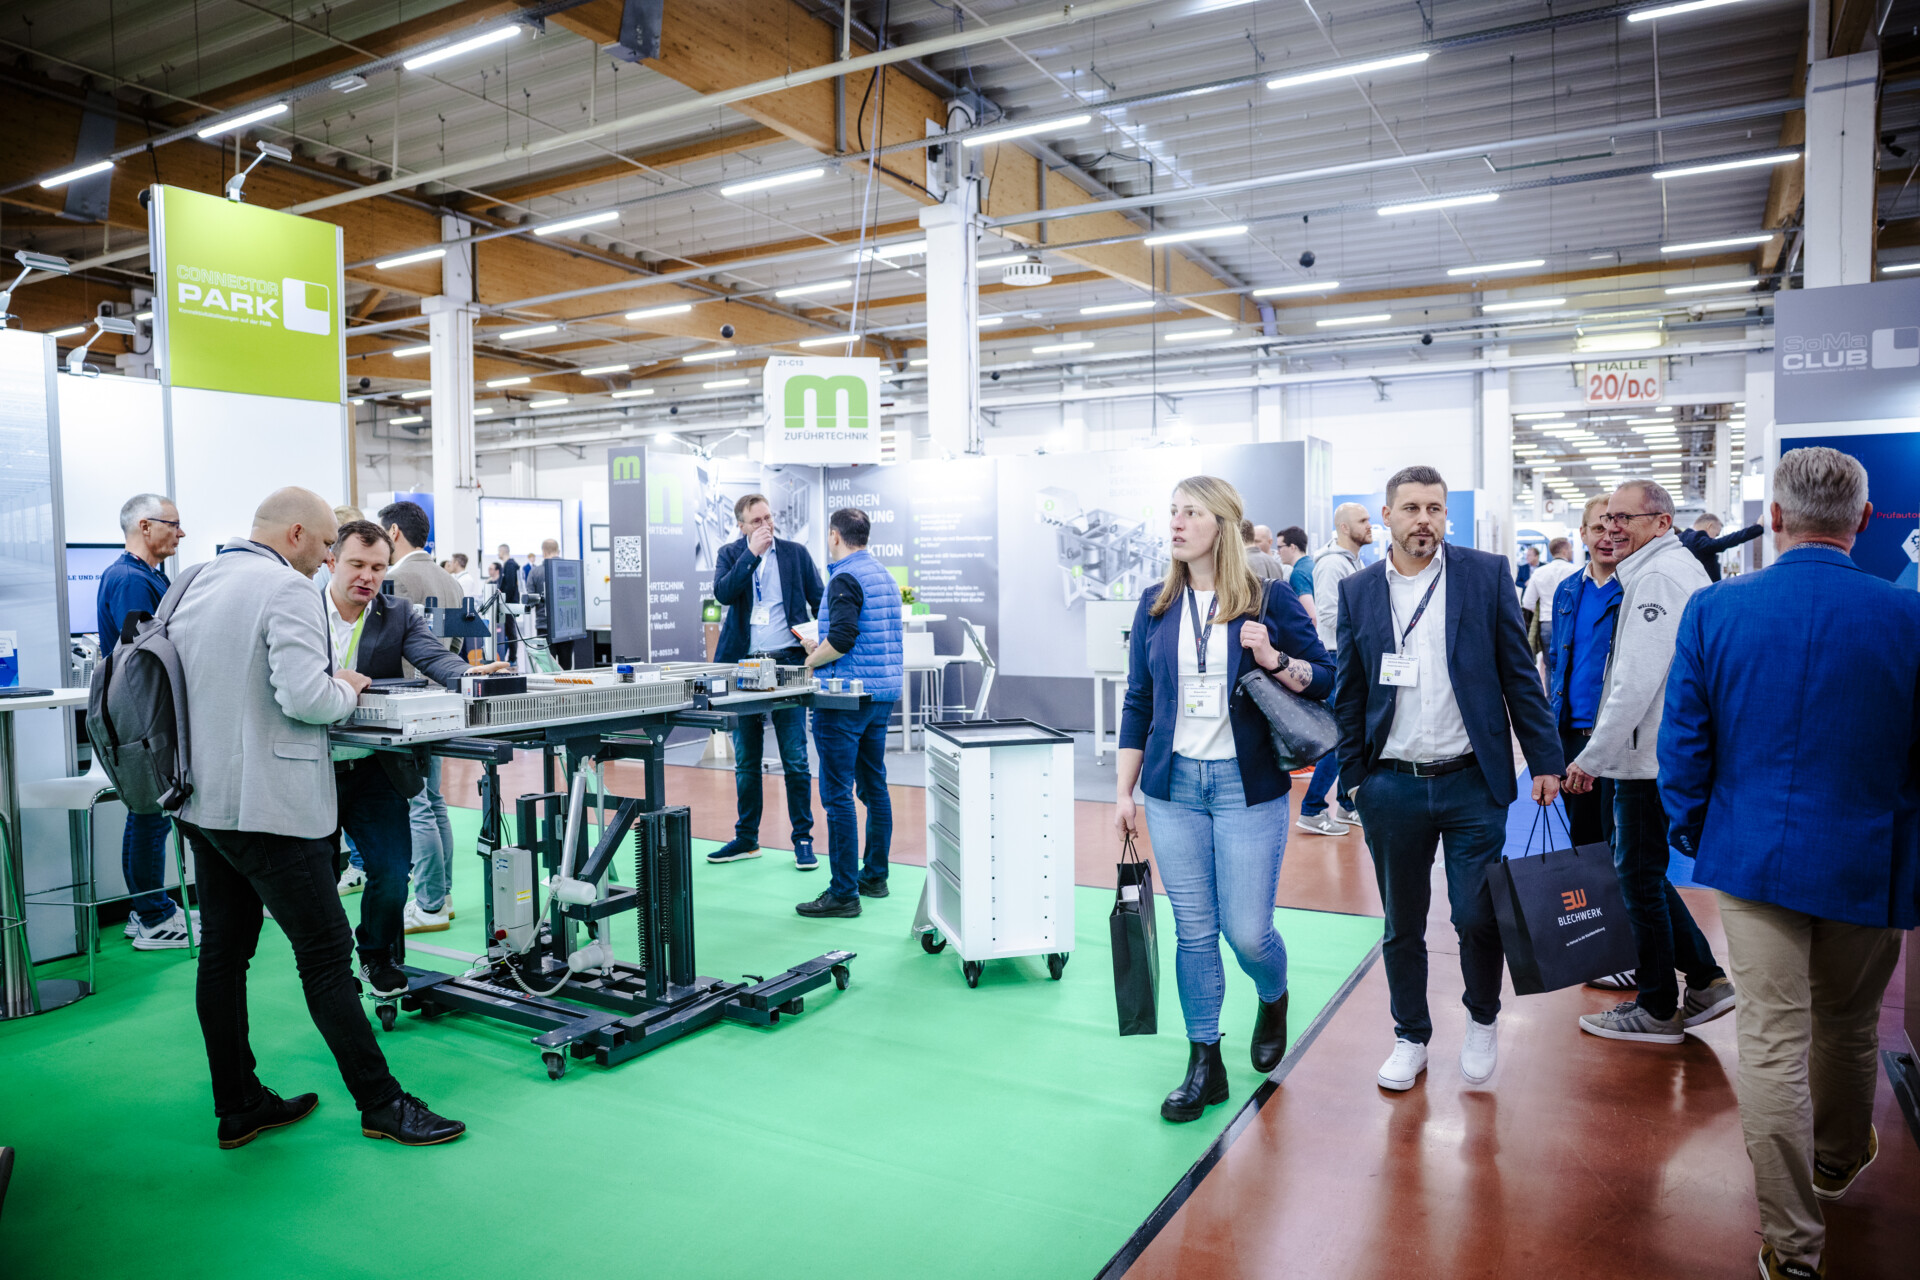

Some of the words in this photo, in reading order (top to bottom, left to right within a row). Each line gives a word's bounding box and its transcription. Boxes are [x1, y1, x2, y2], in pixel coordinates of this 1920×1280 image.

[177, 264, 279, 296] CONNECTOR
[178, 282, 279, 319] PARK
[1783, 331, 1868, 353] SoMa
[1597, 360, 1648, 371] HALLE
[1782, 349, 1868, 370] CLUB
[784, 430, 868, 440] ZUFÜHRTECHNIK
[829, 478, 850, 491] WIR
[828, 493, 880, 508] BRINGEN
[1876, 511, 1920, 519] Prüfauto
[867, 543, 904, 557] KTION
[649, 581, 685, 591] HRTECHNIK
[660, 593, 679, 603] GMBH
[649, 612, 662, 620] raße
[1557, 907, 1603, 927] BLECHWERK
[1786, 1266, 1811, 1278] adidas
